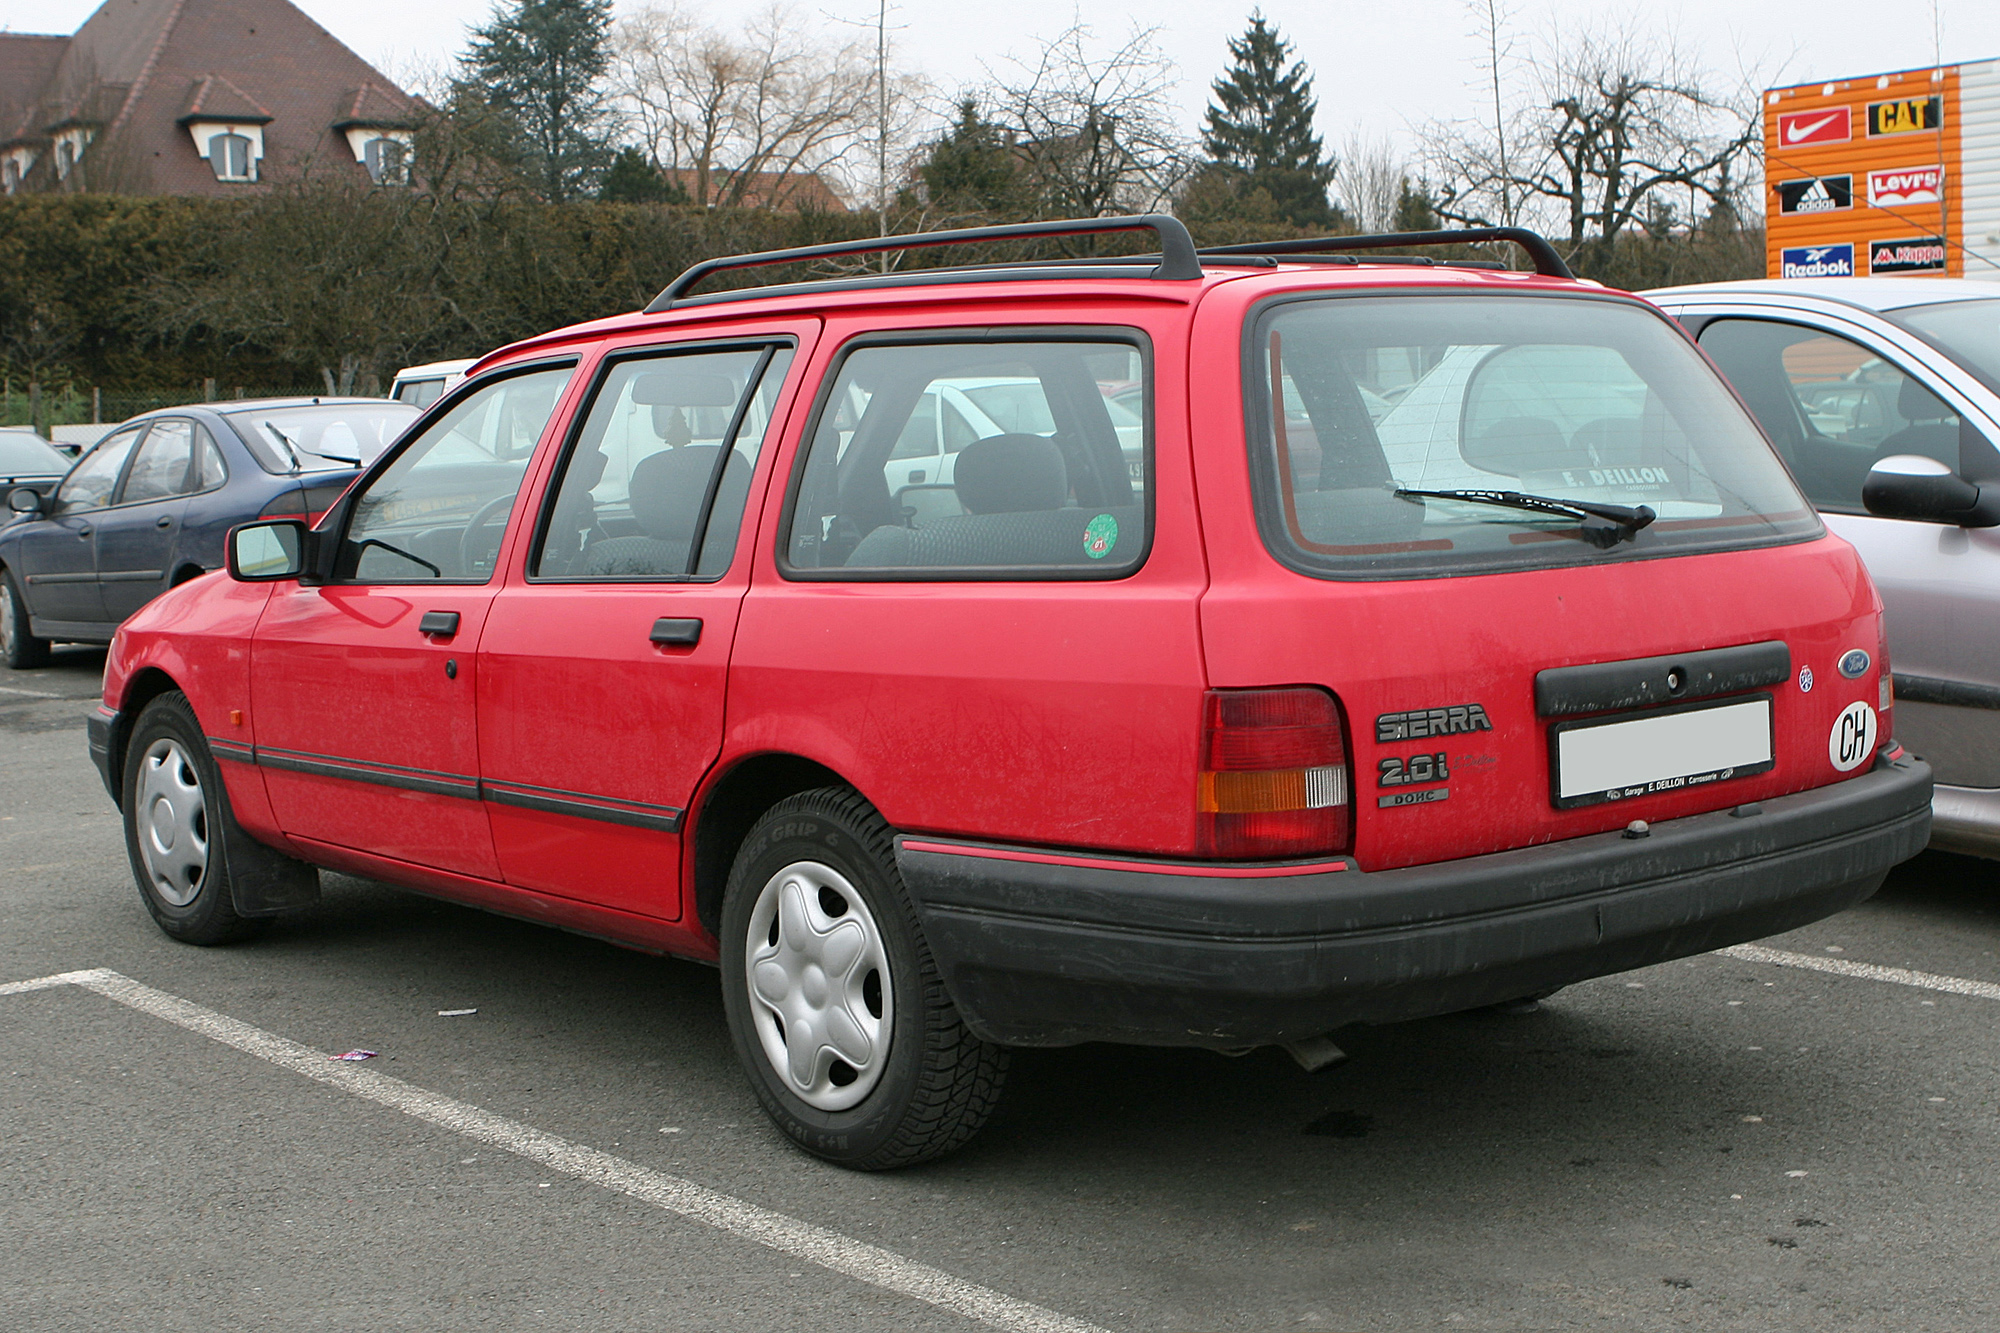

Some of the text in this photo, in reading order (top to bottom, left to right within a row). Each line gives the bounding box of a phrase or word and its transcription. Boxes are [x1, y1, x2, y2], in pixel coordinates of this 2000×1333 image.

[1878, 100, 1929, 134] CAT
[1796, 198, 1836, 212] adidas
[1896, 245, 1944, 266] Kappa
[1784, 259, 1851, 278] Reebok
[1562, 467, 1670, 488] E. DEILLON
[1377, 704, 1492, 743] SIERRA
[1839, 704, 1867, 763] CH
[1624, 787, 1644, 796] Garage
[1656, 777, 1685, 790] DEILLON
[1394, 791, 1435, 805] DOHC
[771, 822, 818, 843] GRIP
